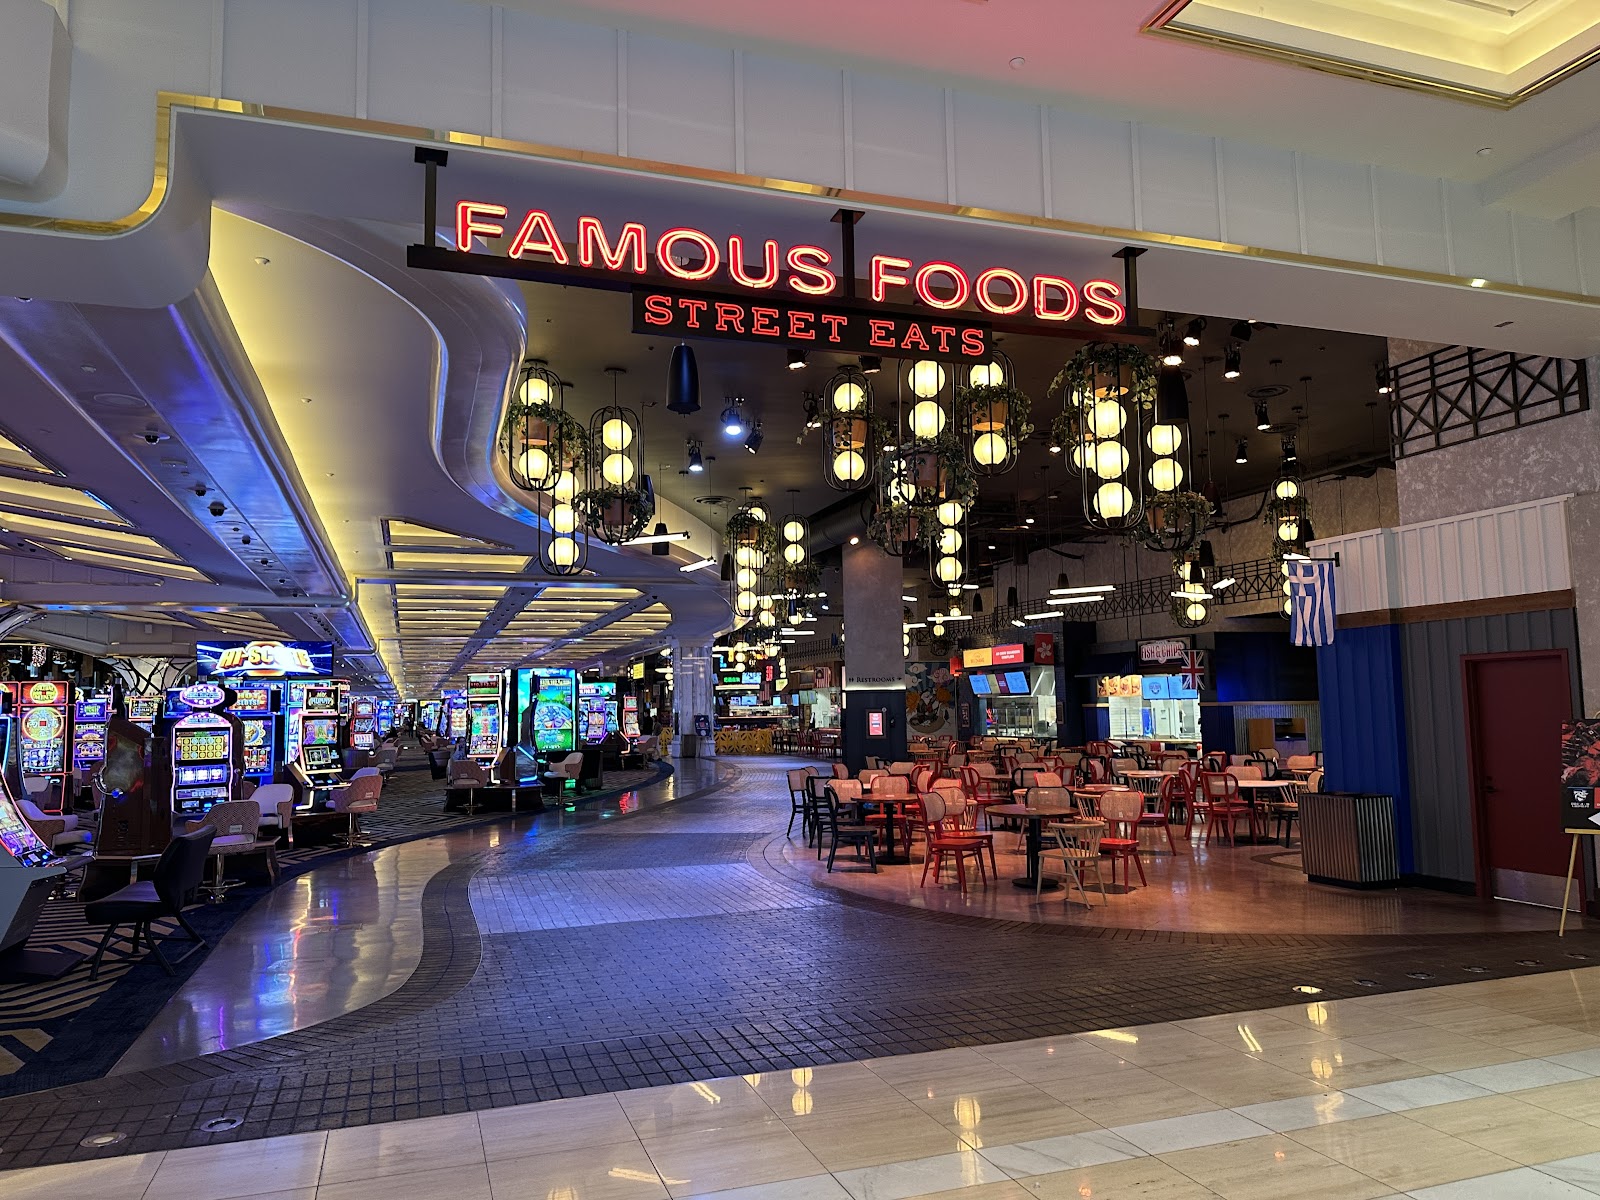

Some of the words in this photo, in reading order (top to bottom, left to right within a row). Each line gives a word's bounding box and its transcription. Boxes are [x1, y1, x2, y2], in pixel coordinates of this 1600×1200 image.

[455, 199, 837, 296] FAMOUS
[868, 253, 1126, 326] FOODS
[644, 295, 848, 343] STREET
[868, 318, 985, 356] EATS
[217, 647, 311, 670] HI-SCE
[1141, 645, 1155, 659] FISH
[1155, 645, 1161, 658] &
[1161, 643, 1183, 658] CHIPS
